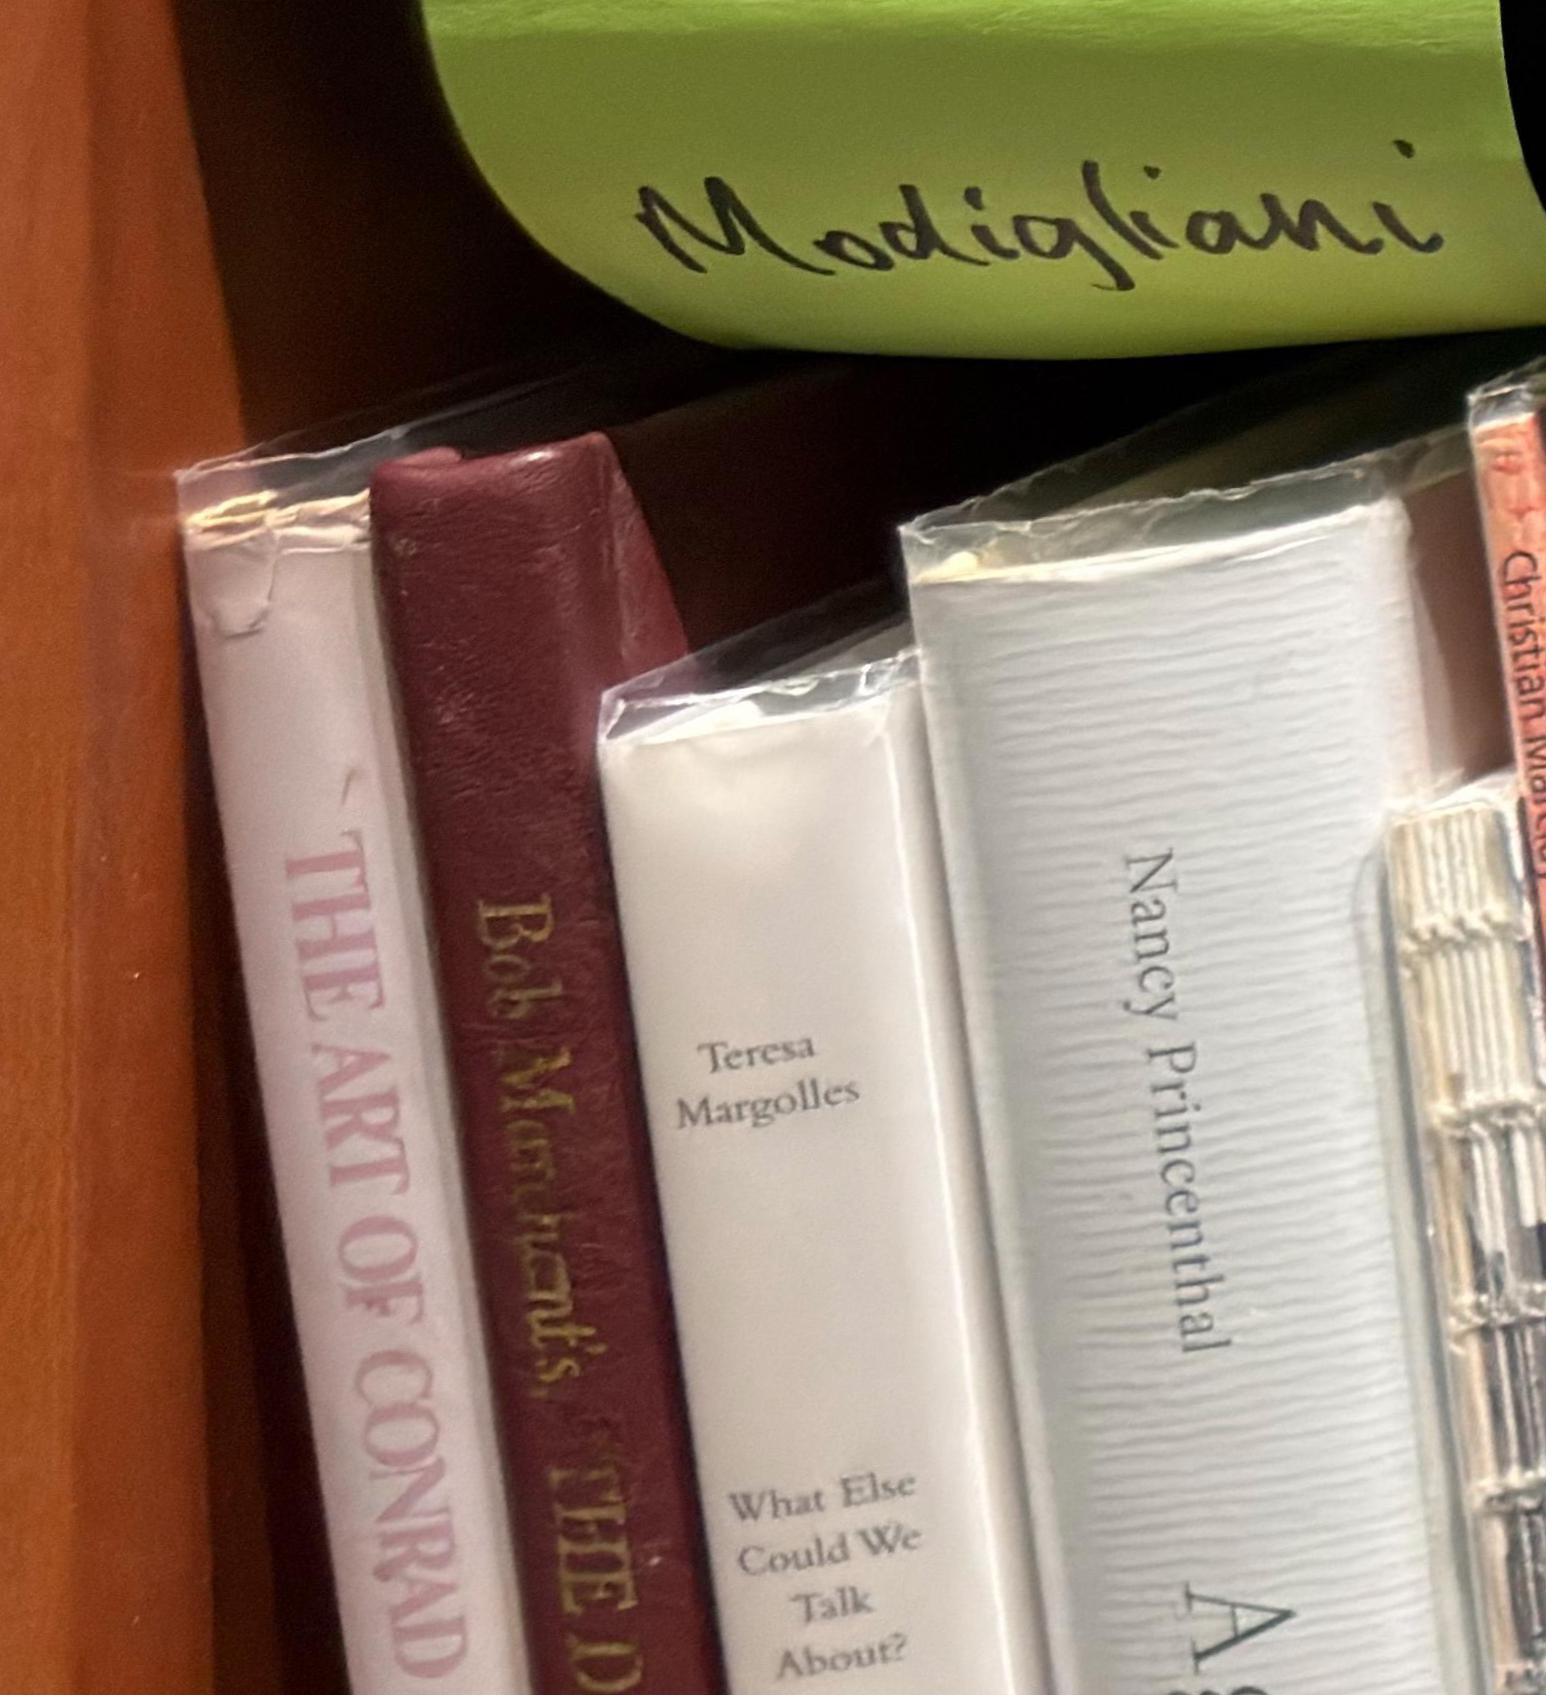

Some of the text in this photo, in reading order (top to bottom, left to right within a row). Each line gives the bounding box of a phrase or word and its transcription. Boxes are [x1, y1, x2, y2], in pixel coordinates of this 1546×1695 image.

[636, 140, 1444, 292] Modigliani
[285, 829, 386, 1021] THE
[478, 895, 564, 1020] Bob
[676, 1078, 863, 1130] Margolles
[697, 1035, 817, 1074] Teresa
[1124, 848, 1232, 1355] Nancy Princenthal
[312, 1043, 409, 1194] ART
[338, 1215, 424, 1336] OF
[353, 1348, 471, 1679] CONRAD
[728, 1471, 917, 1524] What Else
[738, 1520, 923, 1577] Could We
[776, 1632, 908, 1682] About?
[792, 1589, 875, 1628] Talk
